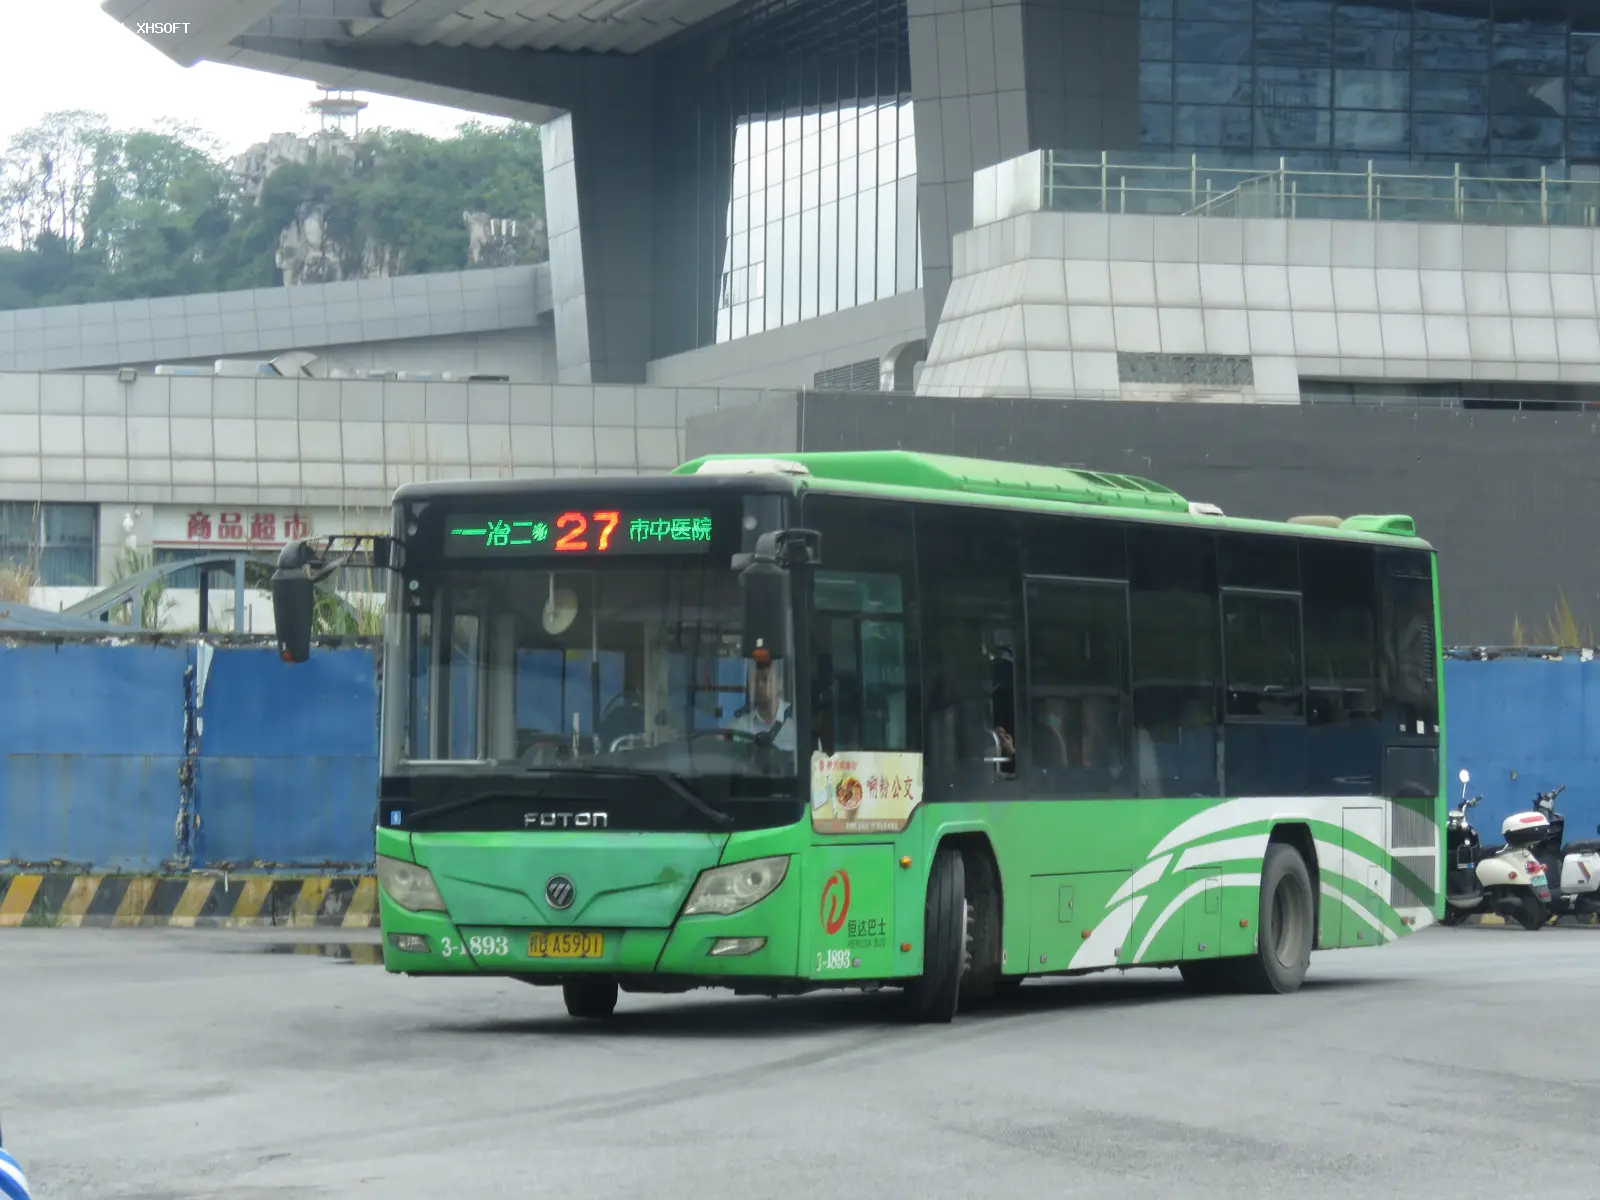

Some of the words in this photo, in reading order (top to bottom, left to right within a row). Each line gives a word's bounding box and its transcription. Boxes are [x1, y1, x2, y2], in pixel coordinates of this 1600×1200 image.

[187, 511, 309, 540] 商品超市
[555, 511, 620, 551] 27
[629, 517, 712, 542] 市中医院
[847, 917, 887, 938] 恒达巴士
[441, 935, 509, 957] 3-1893
